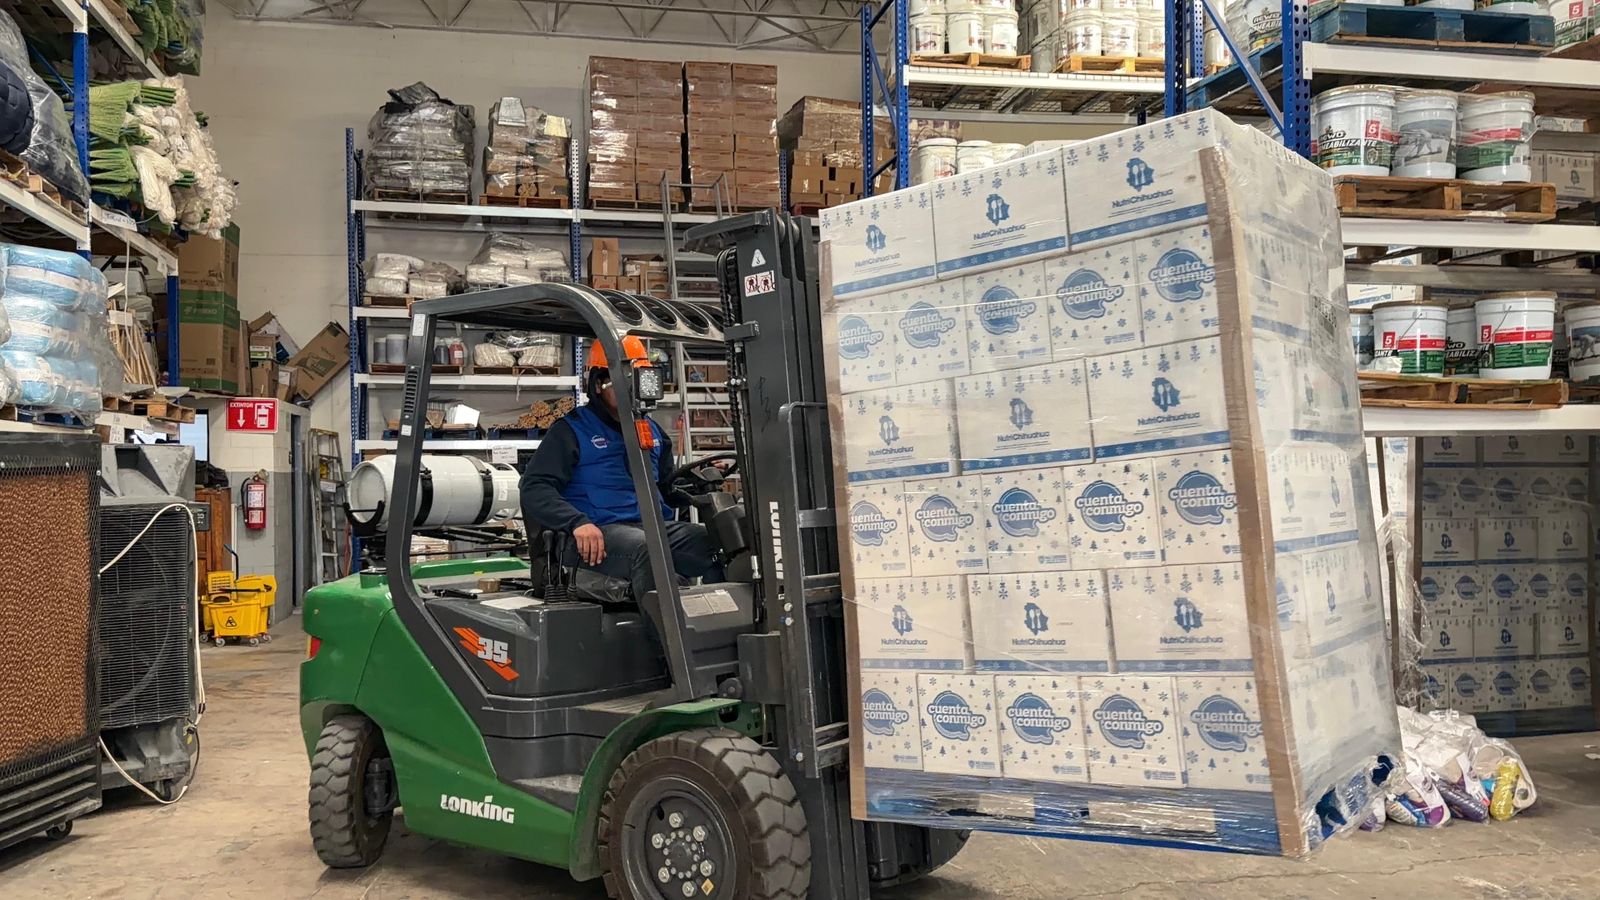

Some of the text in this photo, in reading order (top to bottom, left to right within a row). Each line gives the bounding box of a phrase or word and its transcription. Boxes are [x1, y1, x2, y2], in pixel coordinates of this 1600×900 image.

[1150, 260, 1201, 279] cuenta
[1159, 268, 1215, 287] conmig
[1057, 280, 1104, 297] cuenta
[1066, 285, 1123, 305] conmigo
[983, 302, 1035, 320] conmigo
[900, 312, 939, 328] cuenta
[907, 318, 955, 335] conmigo
[838, 326, 869, 338] uenta
[839, 332, 883, 347] conmigo
[1385, 335, 1393, 345] 5
[1137, 412, 1200, 426] NutriChihuahua
[1170, 485, 1222, 499] cuenta
[993, 501, 1038, 513] cuenta
[1076, 493, 1124, 507] cuenta
[916, 507, 957, 519] cuenta
[1002, 508, 1055, 522] conmigo
[1084, 501, 1143, 517] conmigo
[851, 512, 883, 523] uenta
[923, 514, 973, 529] conmigo
[853, 520, 896, 534] conmigo
[881, 638, 928, 646] NutriChihuahua
[1012, 638, 1066, 646] NutriChihuahua
[477, 637, 508, 664] 35
[863, 702, 893, 712] uenta
[928, 704, 970, 714] cuenta
[1008, 707, 1053, 718] cuenta
[864, 710, 908, 723] conmigo
[935, 713, 985, 727] conmigo
[1094, 709, 1144, 721] cuenta
[1192, 711, 1245, 723] cuenta
[1016, 716, 1070, 731] conmigo
[1104, 720, 1163, 735] conmigo
[441, 794, 514, 824] LONKING
